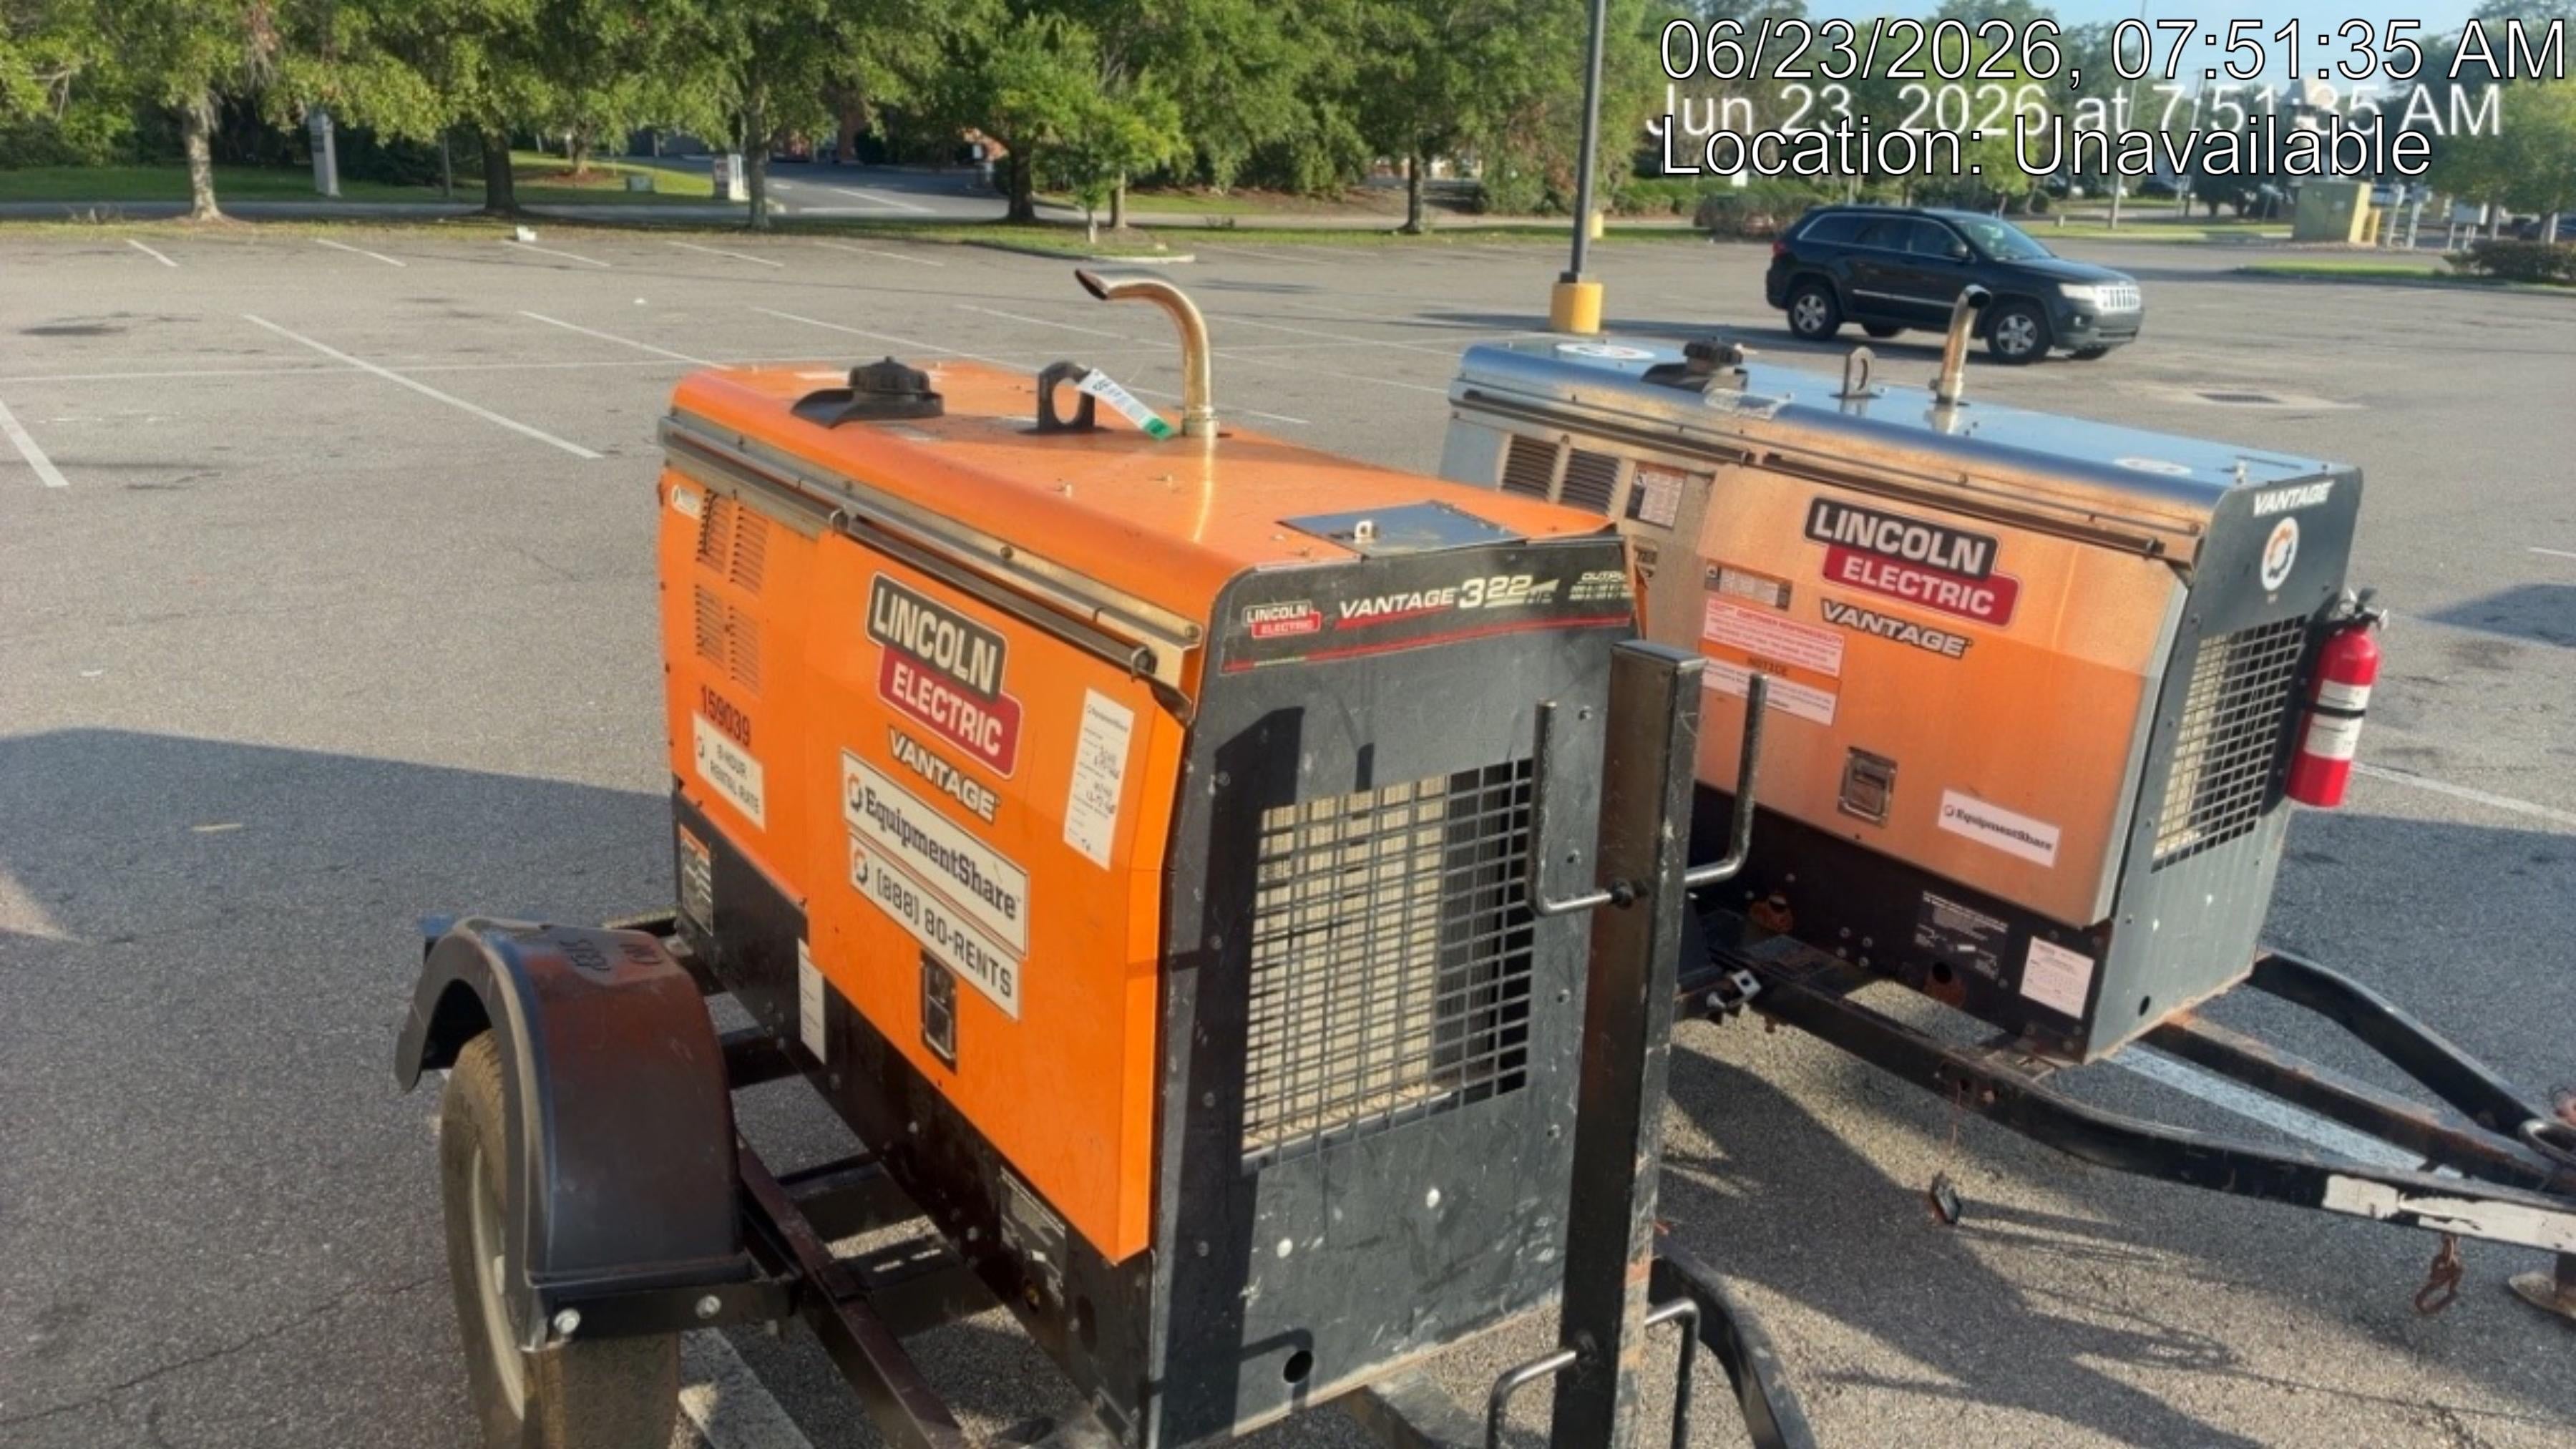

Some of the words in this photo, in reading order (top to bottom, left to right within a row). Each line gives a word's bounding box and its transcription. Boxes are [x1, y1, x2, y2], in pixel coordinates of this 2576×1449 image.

[2253, 480, 2334, 516] VANTAGE
[1813, 503, 1985, 574] LINCOLN
[1340, 587, 1460, 620] VANTAGE
[1459, 574, 1533, 609] 322
[1581, 570, 1627, 582] OUTPU
[1843, 555, 1995, 615] ELECTRIC
[874, 587, 997, 695] LINCOLN
[1247, 605, 1308, 623] LINCOLN
[1822, 598, 1972, 659] VANTAGE
[701, 685, 750, 747] 159039
[892, 660, 1002, 757] ELECTRIC
[888, 725, 998, 824] VANTAGE
[864, 786, 1018, 922] EquipmentShare
[1956, 808, 2052, 850] EquipmentShare
[877, 867, 919, 926] (888)
[924, 908, 1013, 998] 80-RENTS
